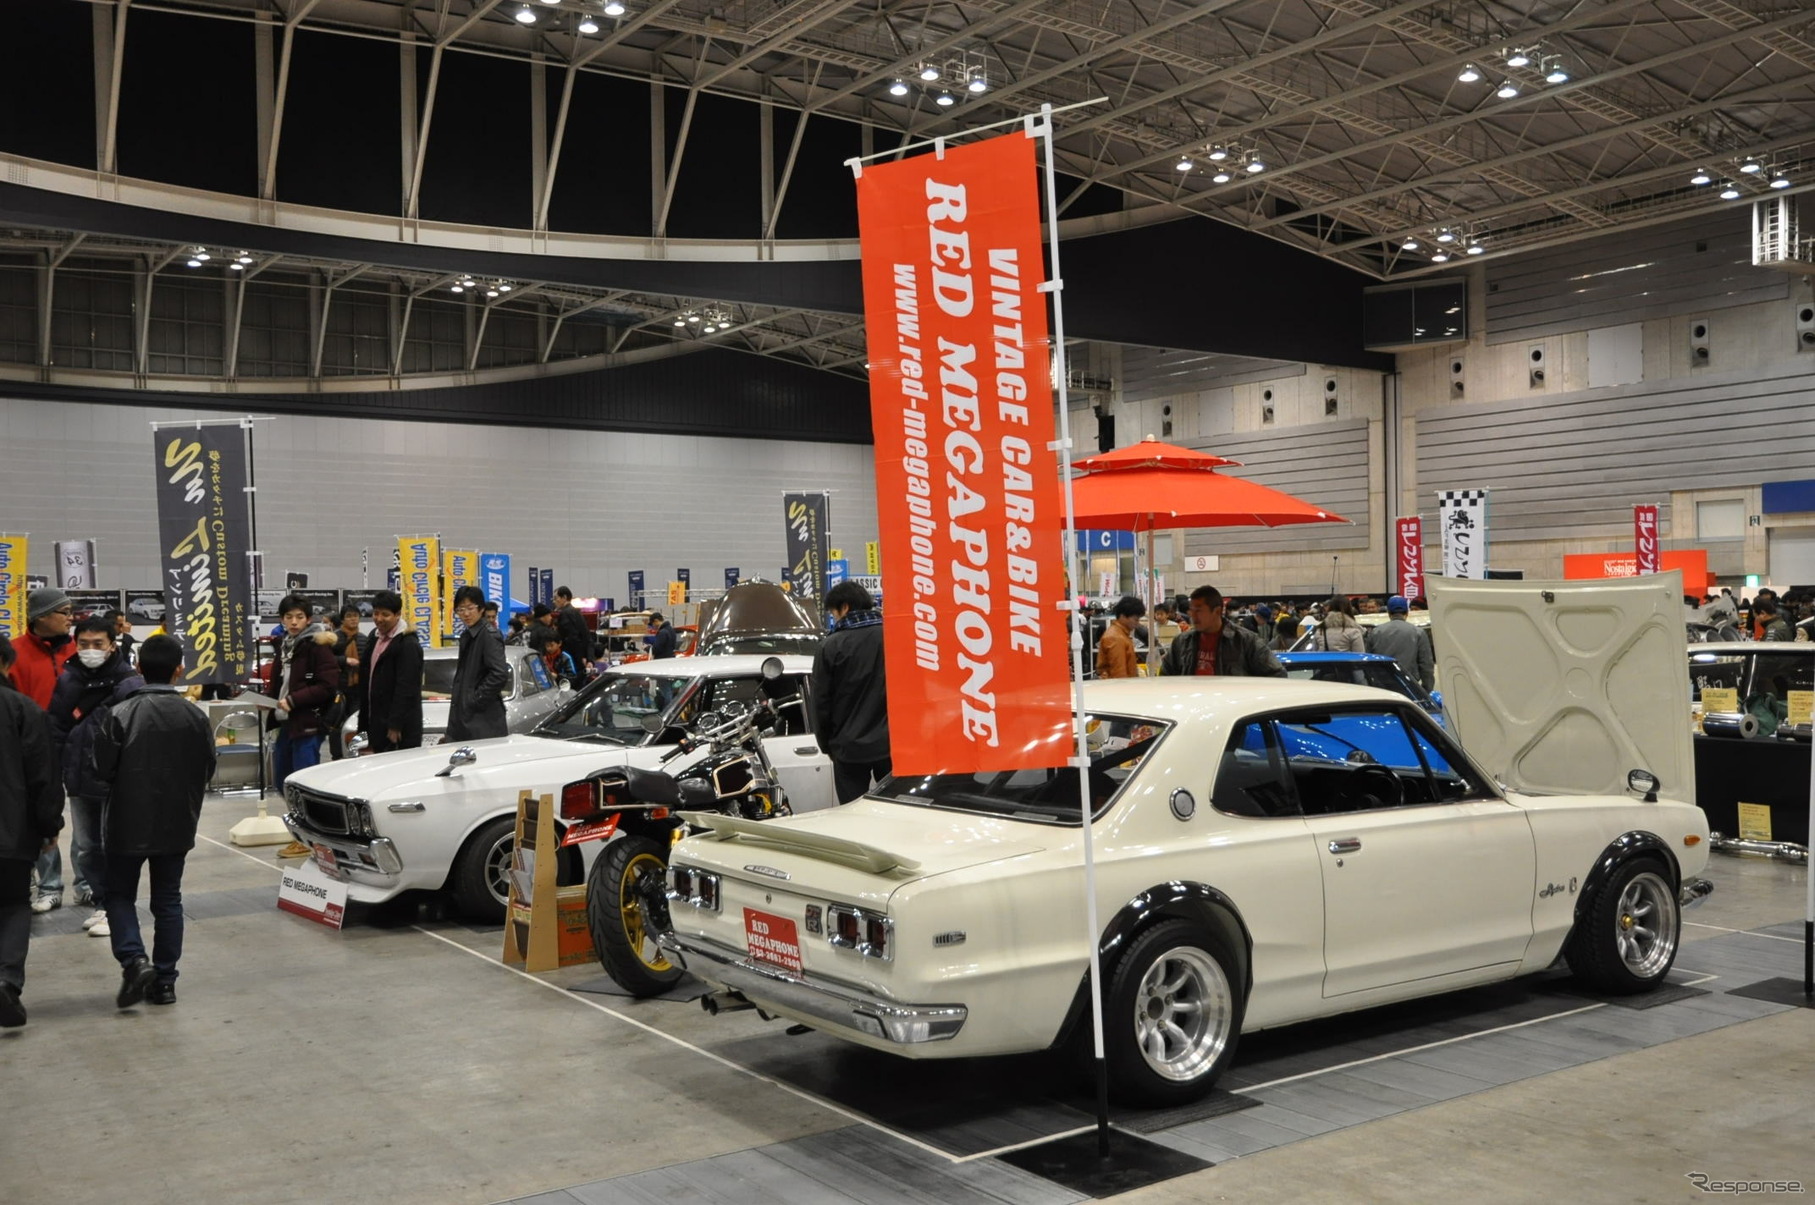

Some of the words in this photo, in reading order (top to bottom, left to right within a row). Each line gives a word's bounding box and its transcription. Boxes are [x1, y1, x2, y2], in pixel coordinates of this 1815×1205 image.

[925, 178, 975, 318] RED
[988, 248, 1030, 426] VINTAGE
[893, 263, 940, 672] www.red-megaphone.com
[453, 555, 467, 577] Auto
[937, 335, 999, 747] MEGAPHONE
[1000, 434, 1042, 658] CAR&BIKE
[1101, 531, 1111, 547] C
[283, 876, 294, 889] RED
[294, 880, 328, 900] MEGAPHONE
[751, 919, 769, 934] RED
[747, 932, 799, 958] MEGAPHONE
